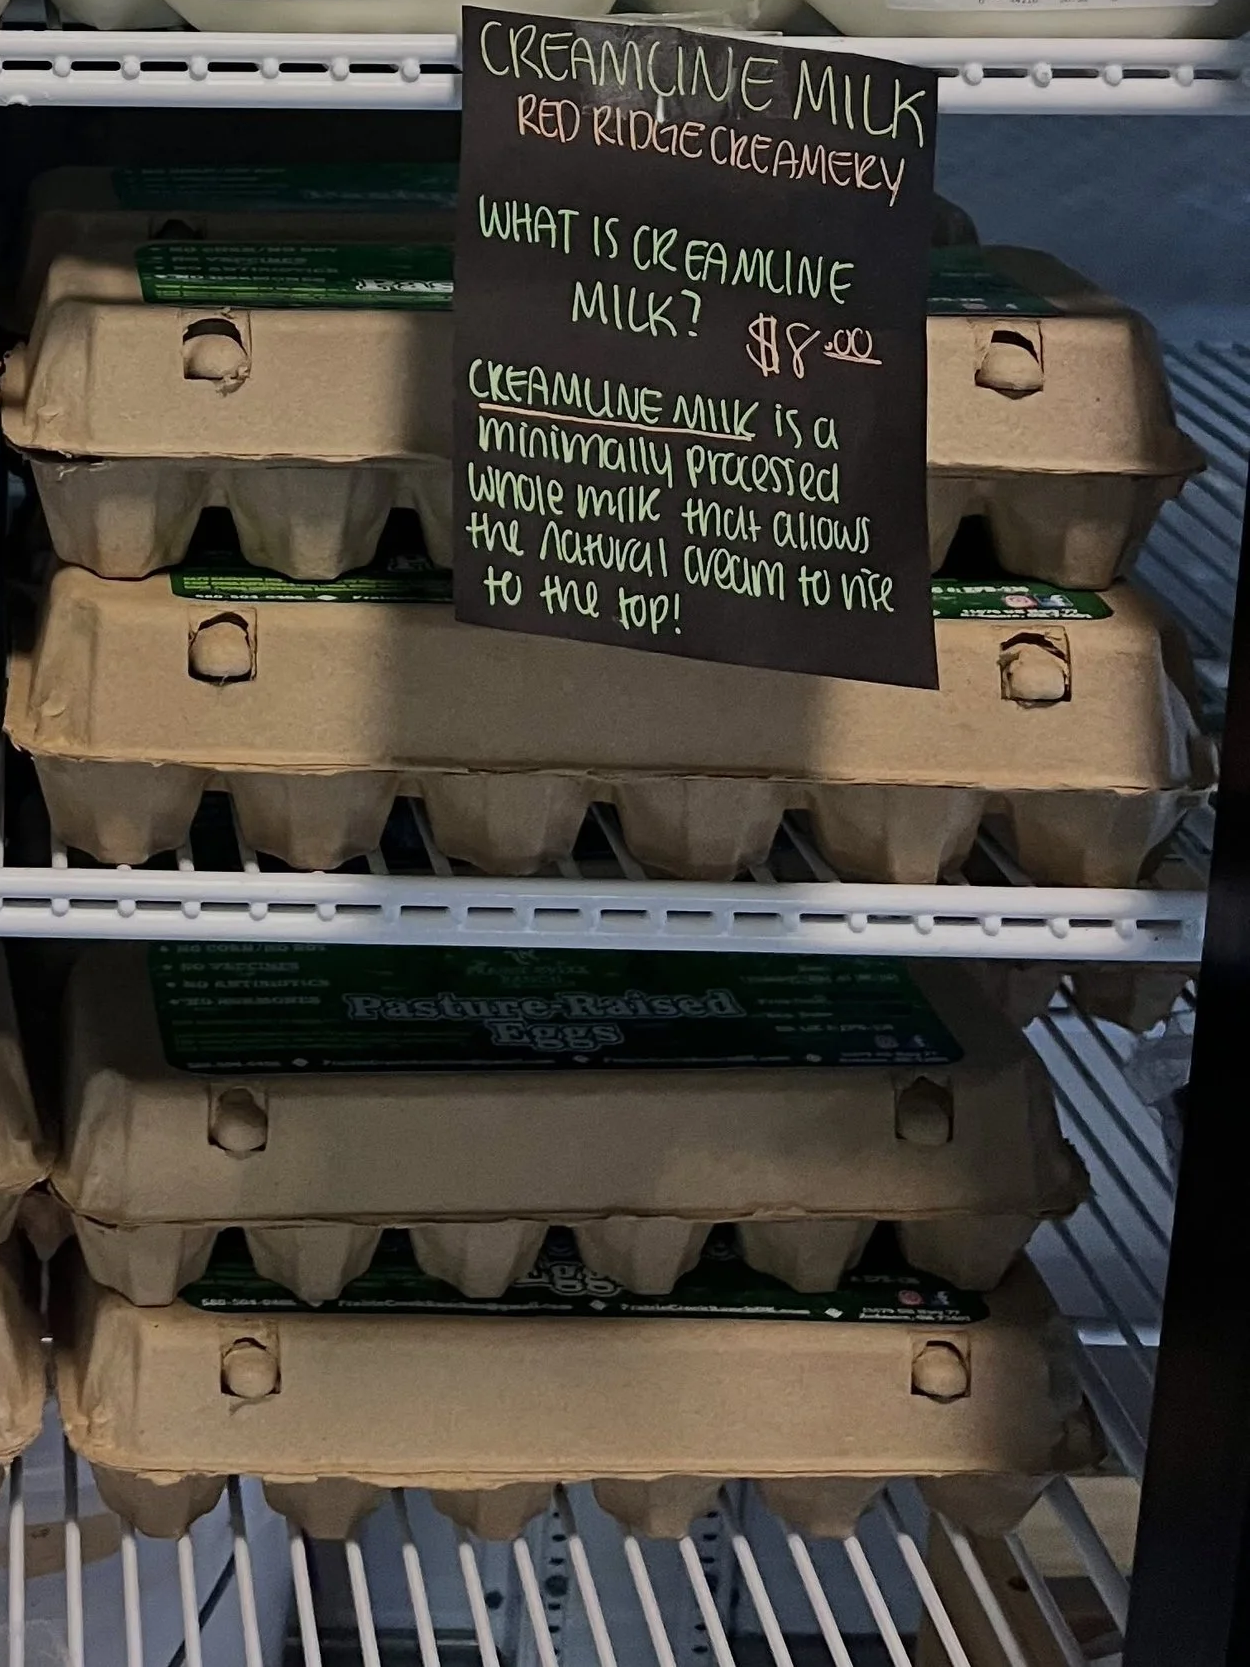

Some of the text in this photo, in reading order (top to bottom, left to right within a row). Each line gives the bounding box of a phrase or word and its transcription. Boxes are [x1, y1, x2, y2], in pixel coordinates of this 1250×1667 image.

[481, 20, 926, 148] CREAMLINE MILK
[517, 93, 904, 206] RED RIDGE CREAMERY
[479, 194, 579, 254] WHAT
[594, 215, 619, 259] IS
[633, 224, 854, 304] CREAMLINE
[572, 280, 701, 337] MILK?
[745, 312, 882, 378] $8.00
[468, 358, 838, 451] CREAMLINE MILK is a
[477, 415, 840, 504] minimally processed
[468, 463, 870, 553] whole milk that allows
[466, 513, 524, 557] the
[685, 544, 784, 601] cream
[798, 566, 831, 606] to
[841, 568, 894, 613] rise
[483, 566, 682, 635] to the top!
[342, 989, 746, 1021] Pasture-Raised
[486, 1019, 625, 1052] Eggs
